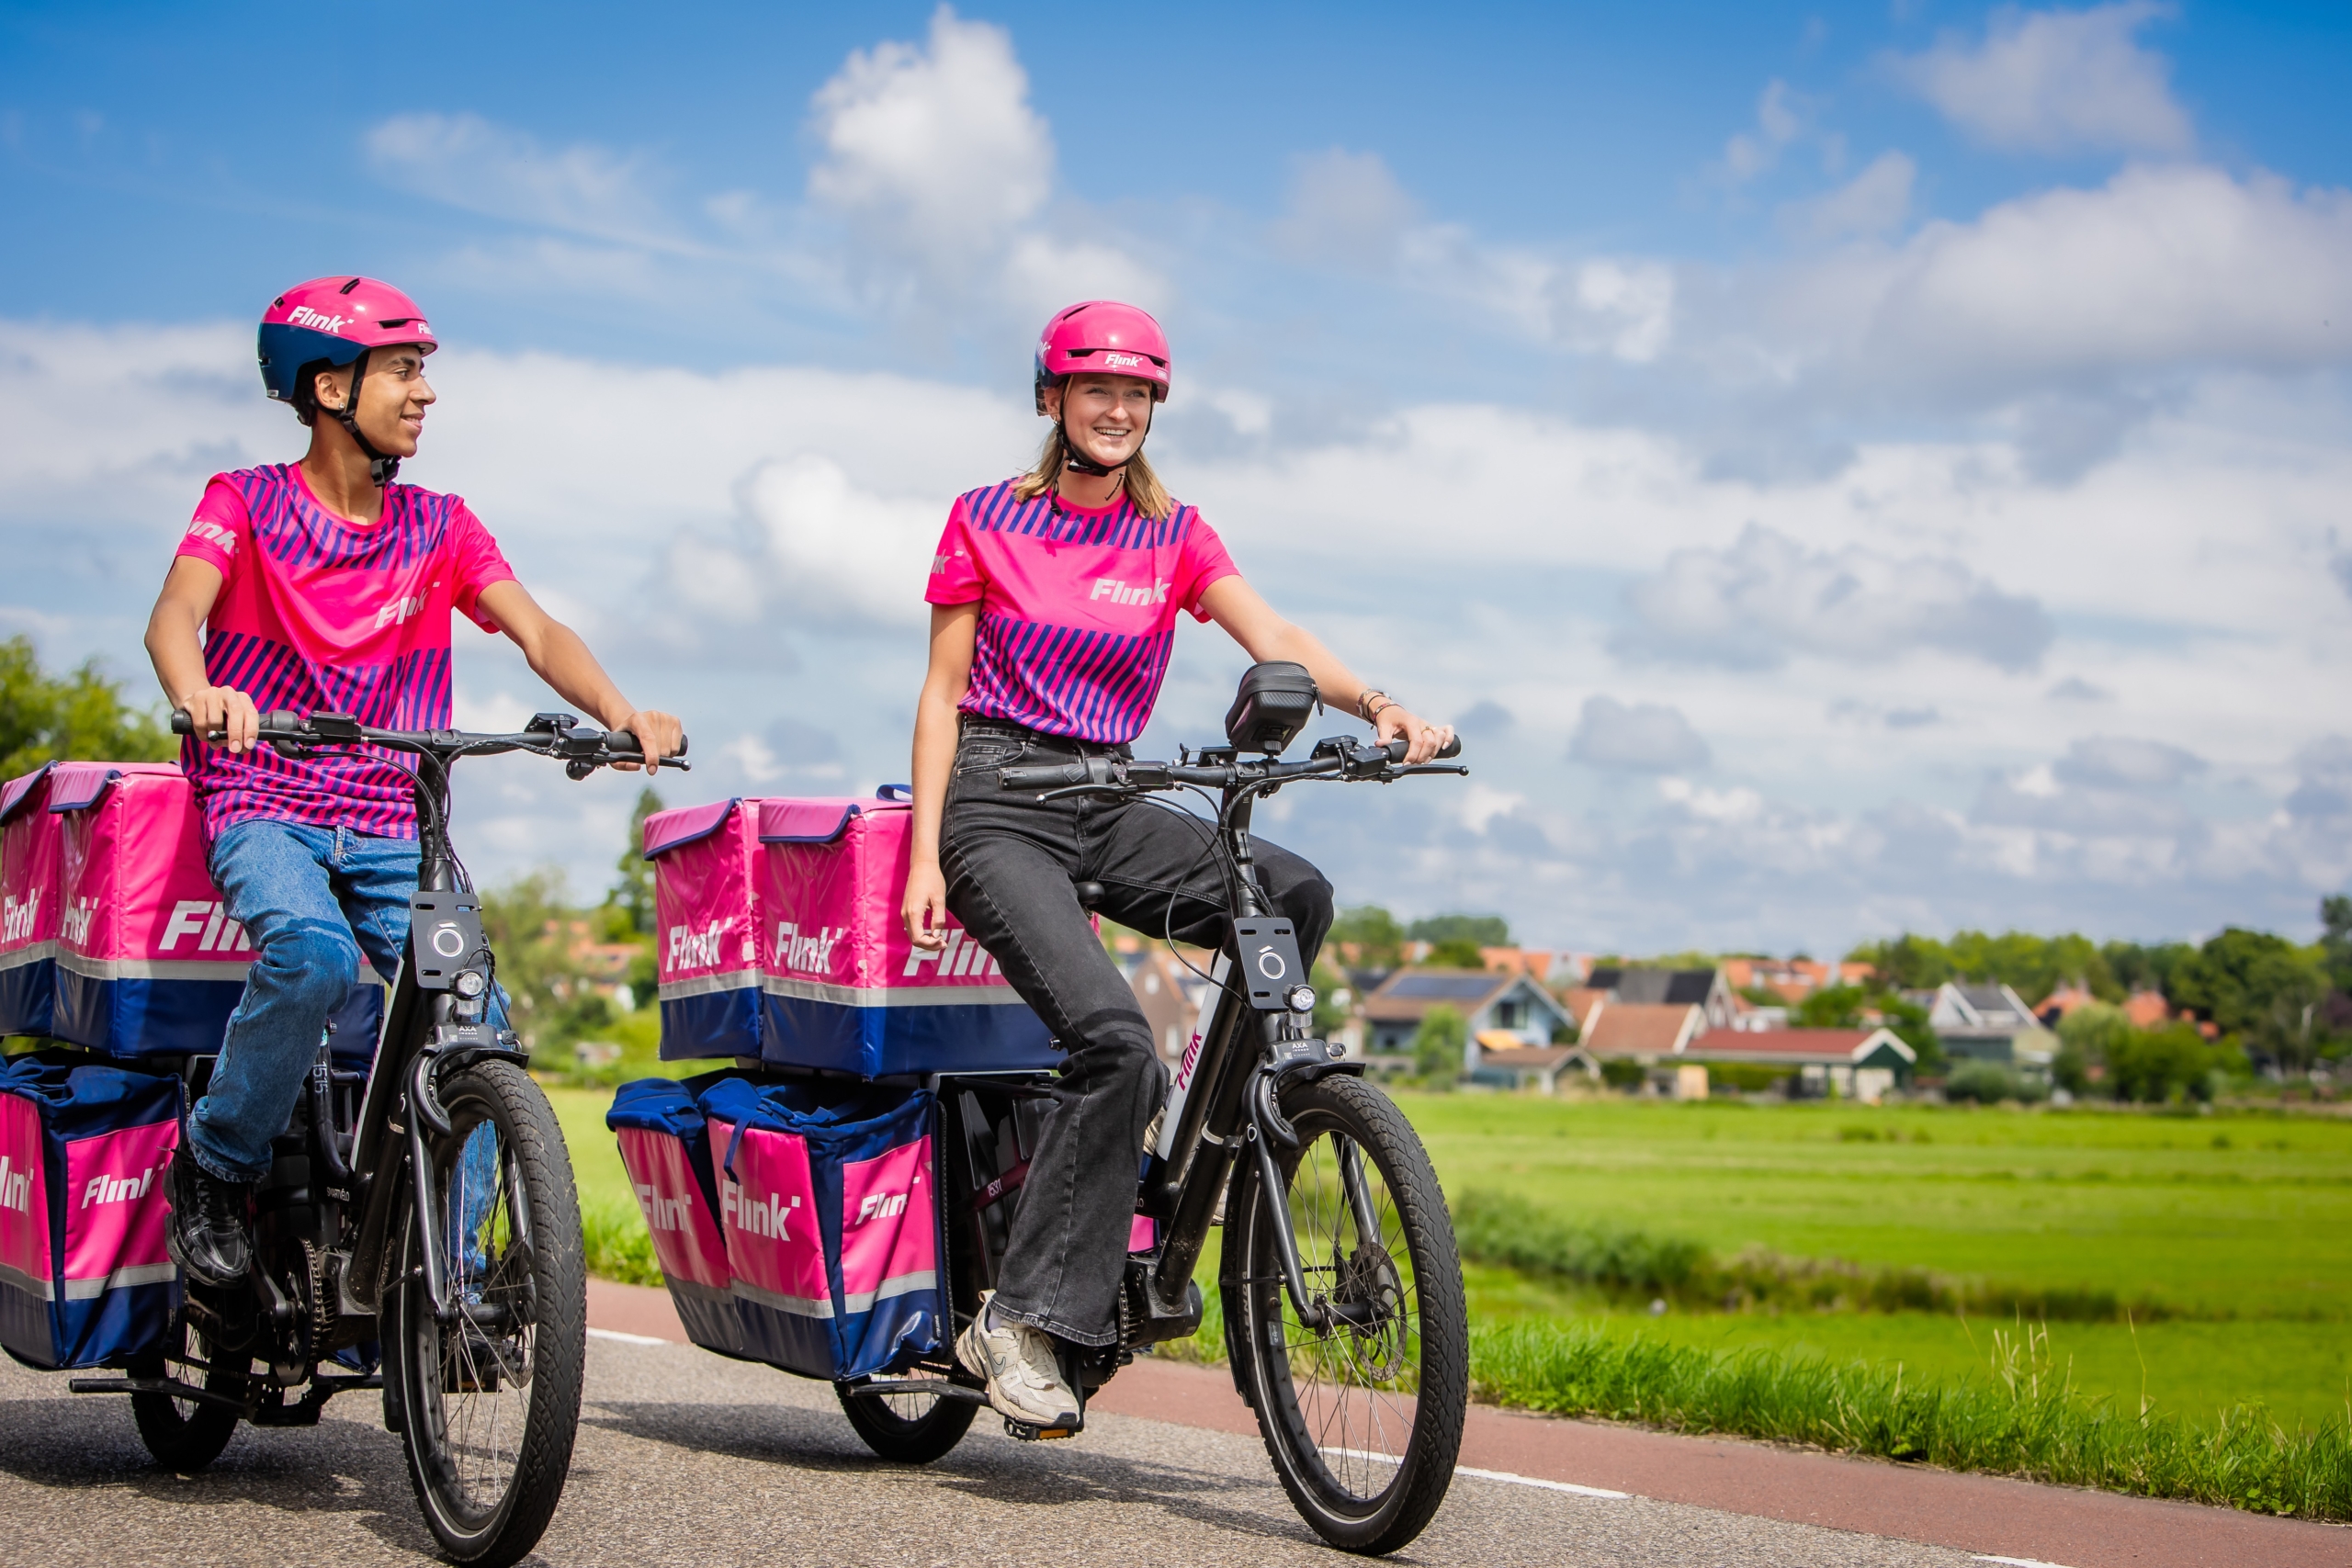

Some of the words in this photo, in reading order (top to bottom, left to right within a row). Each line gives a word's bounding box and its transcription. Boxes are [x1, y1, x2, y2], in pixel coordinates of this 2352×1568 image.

[288, 305, 351, 333] Flink
[1105, 354, 1141, 367] Flink
[1090, 577, 1172, 605] Flink
[666, 919, 729, 972] Flink
[774, 921, 840, 974] Flink
[987, 1178, 1002, 1198] 1531
[722, 1179, 797, 1242] Flink
[1242, 1270, 1252, 1343] KENDA
